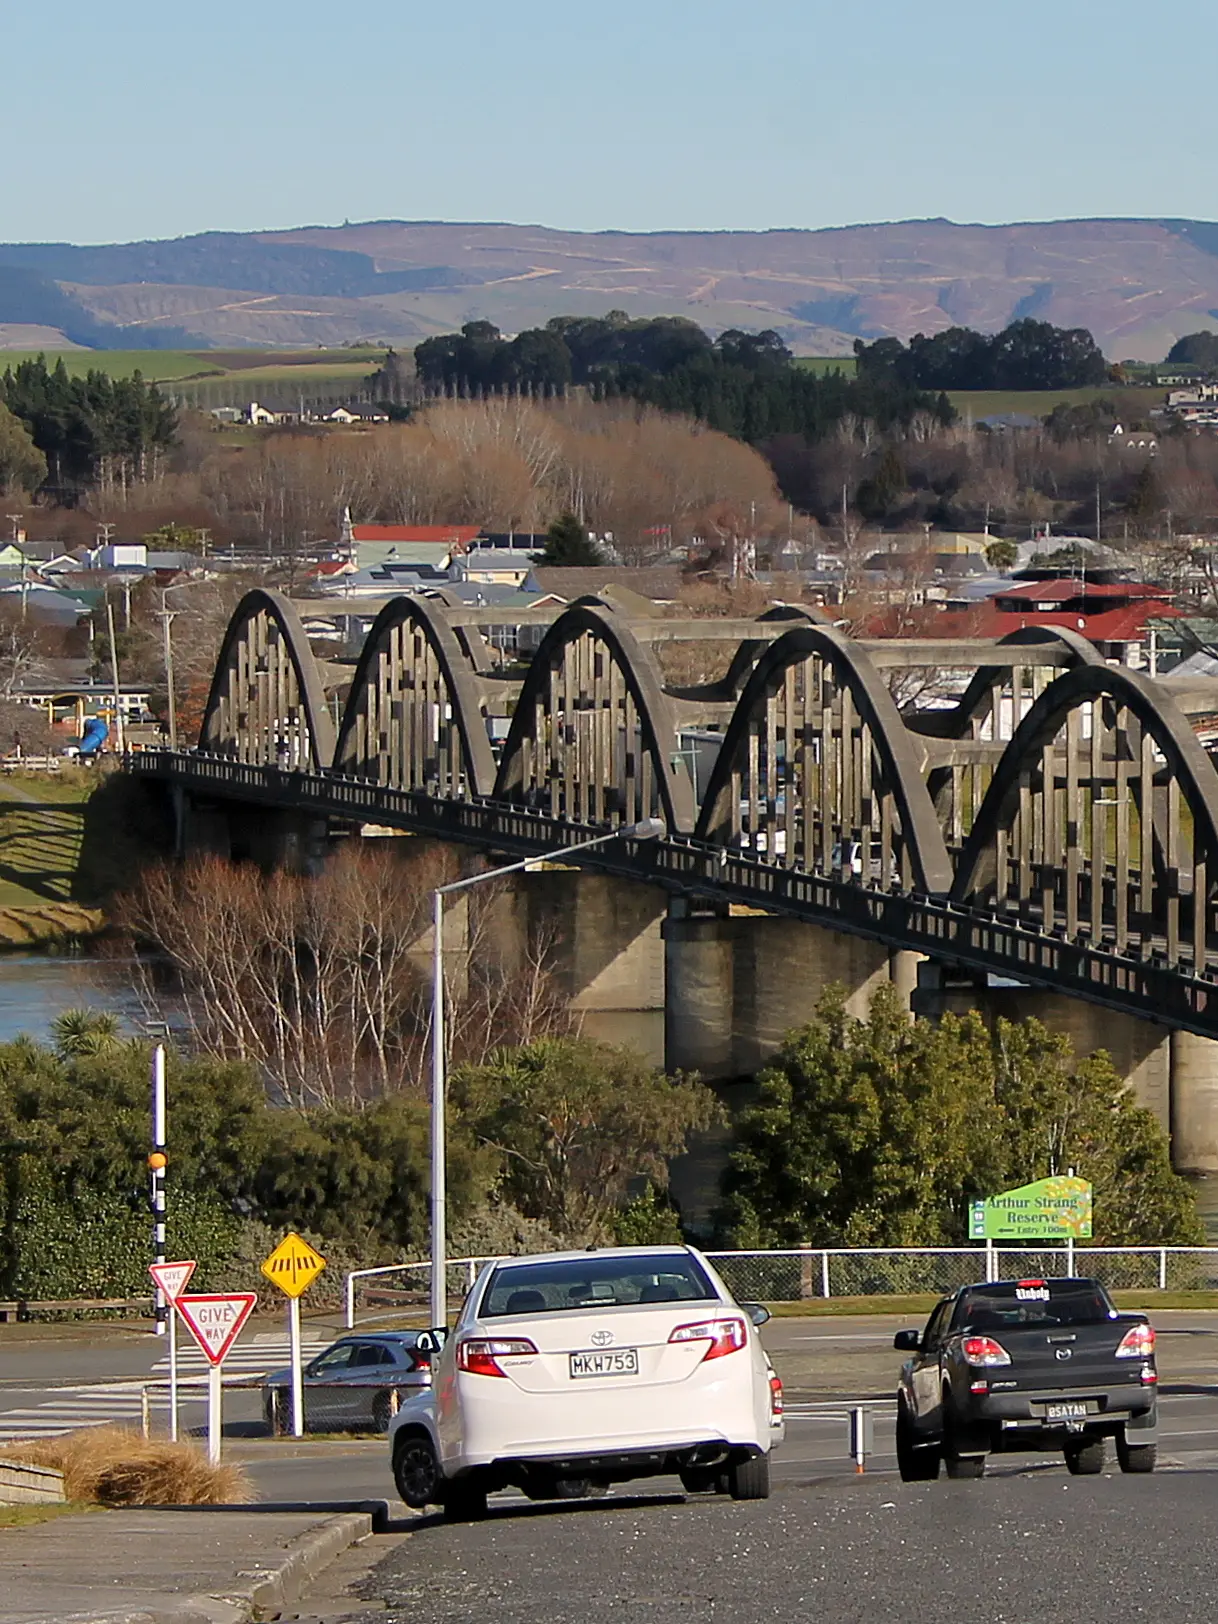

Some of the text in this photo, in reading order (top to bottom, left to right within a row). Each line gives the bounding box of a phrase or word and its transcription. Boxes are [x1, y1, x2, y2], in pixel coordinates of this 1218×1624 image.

[988, 1195, 1078, 1210] Arthur Strang
[1007, 1211, 1058, 1223] Reserve
[1017, 1226, 1039, 1234] Entry
[164, 1271, 181, 1280] GIVE
[199, 1307, 232, 1323] GIVE
[204, 1328, 226, 1340] WAY
